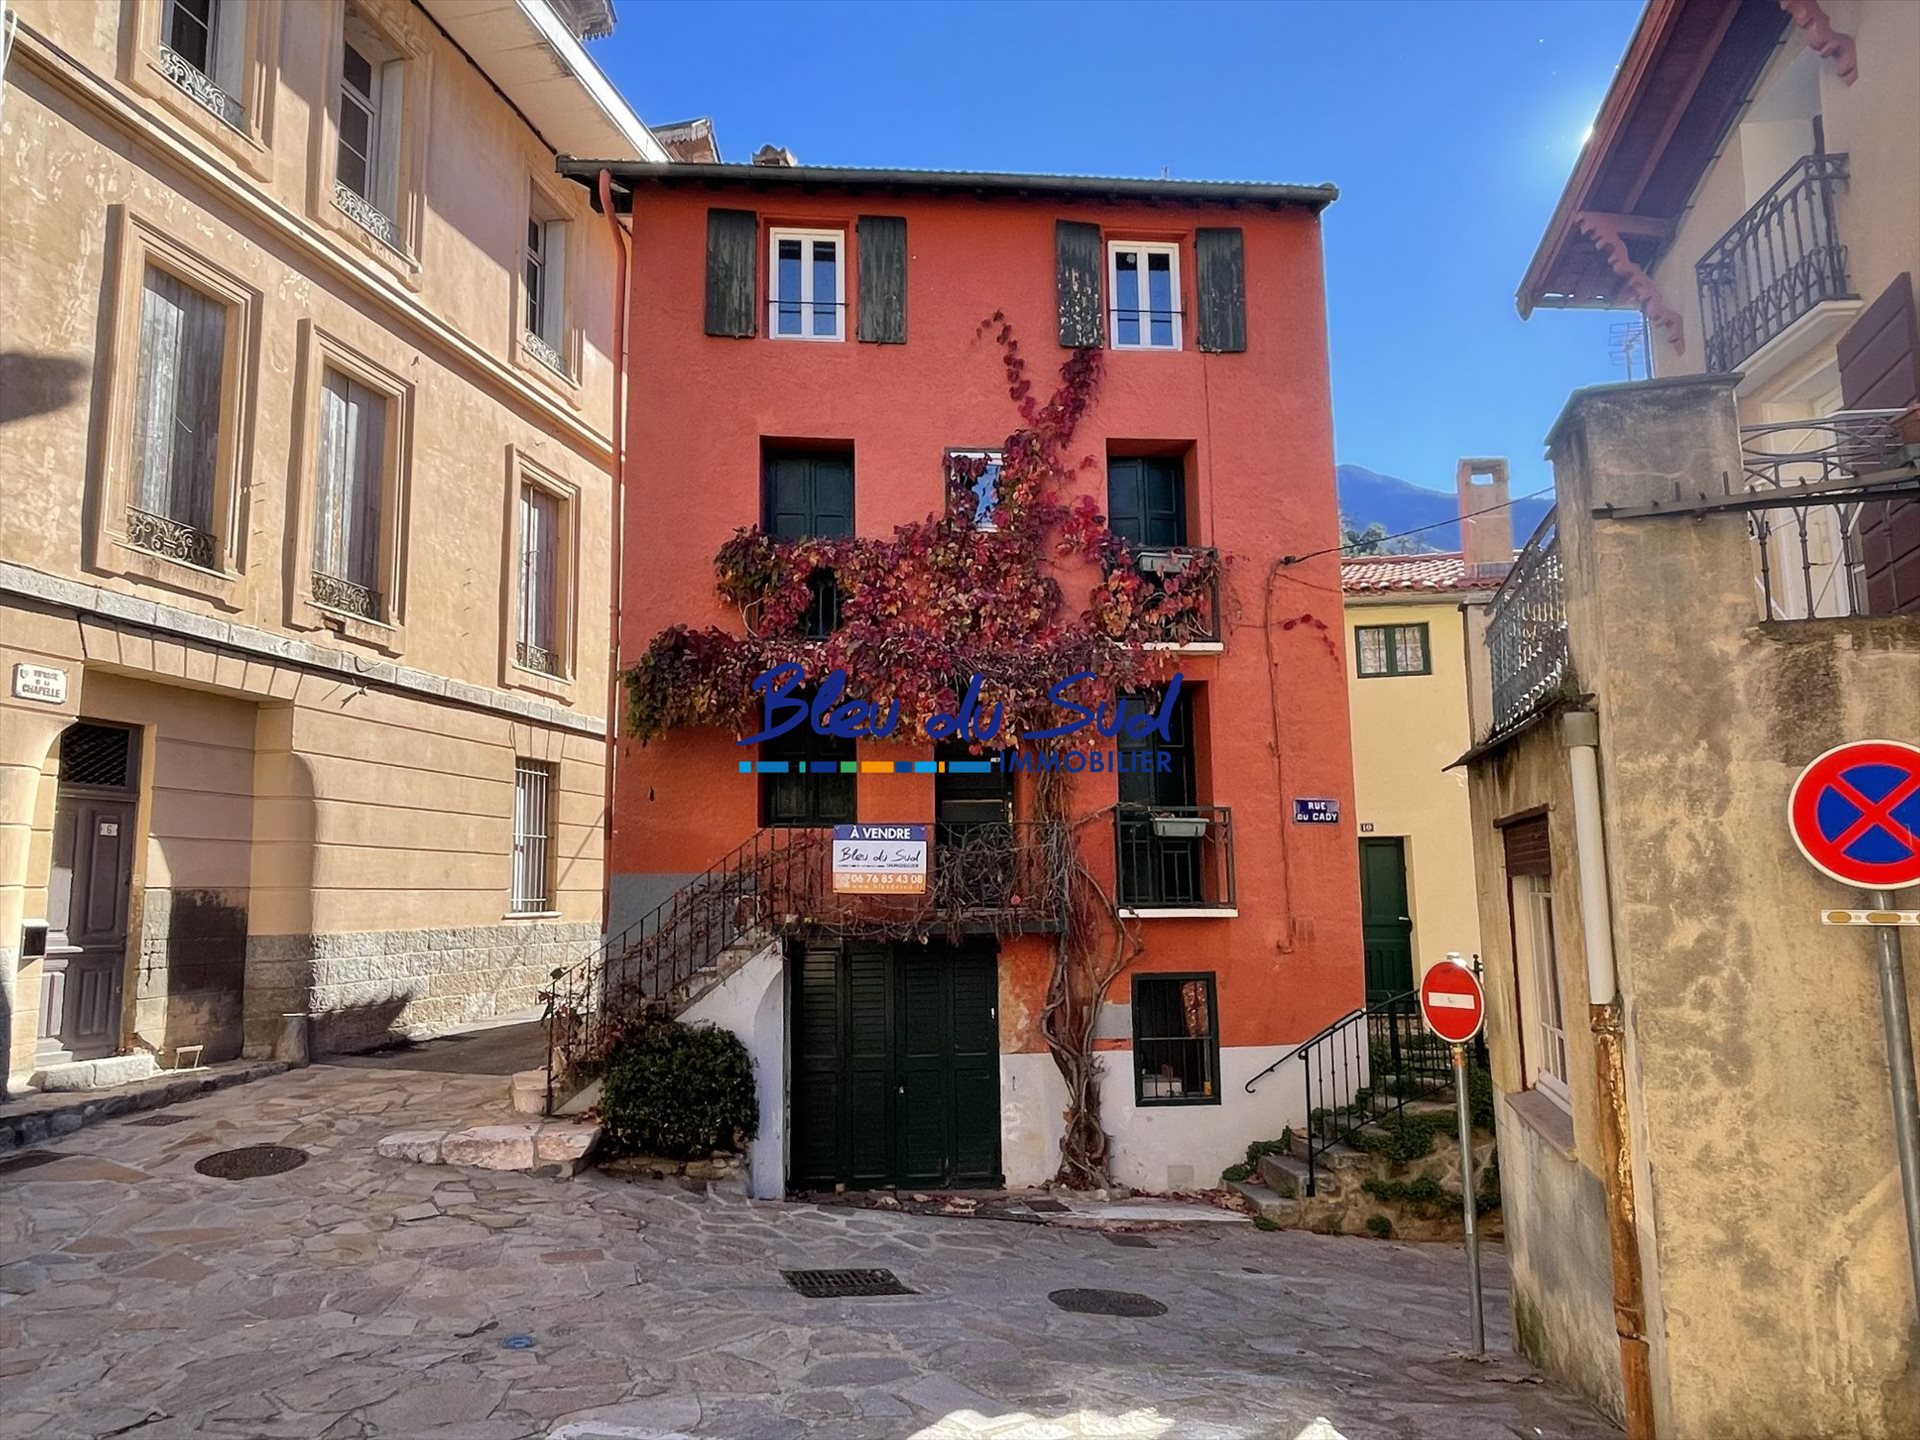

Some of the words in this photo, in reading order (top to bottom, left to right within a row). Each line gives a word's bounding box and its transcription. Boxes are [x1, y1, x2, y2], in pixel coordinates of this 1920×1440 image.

[22, 684, 61, 698] CHAPELLE
[1307, 802, 1326, 810] RUE
[106, 825, 113, 835] 6
[850, 826, 859, 839] À
[863, 828, 911, 839] VENDRE
[838, 847, 868, 862] Bleu
[873, 850, 888, 862] du
[891, 849, 921, 862] Sud
[851, 874, 863, 884] 06
[867, 874, 879, 884] 76
[881, 874, 893, 884] 85
[896, 874, 908, 884] 43
